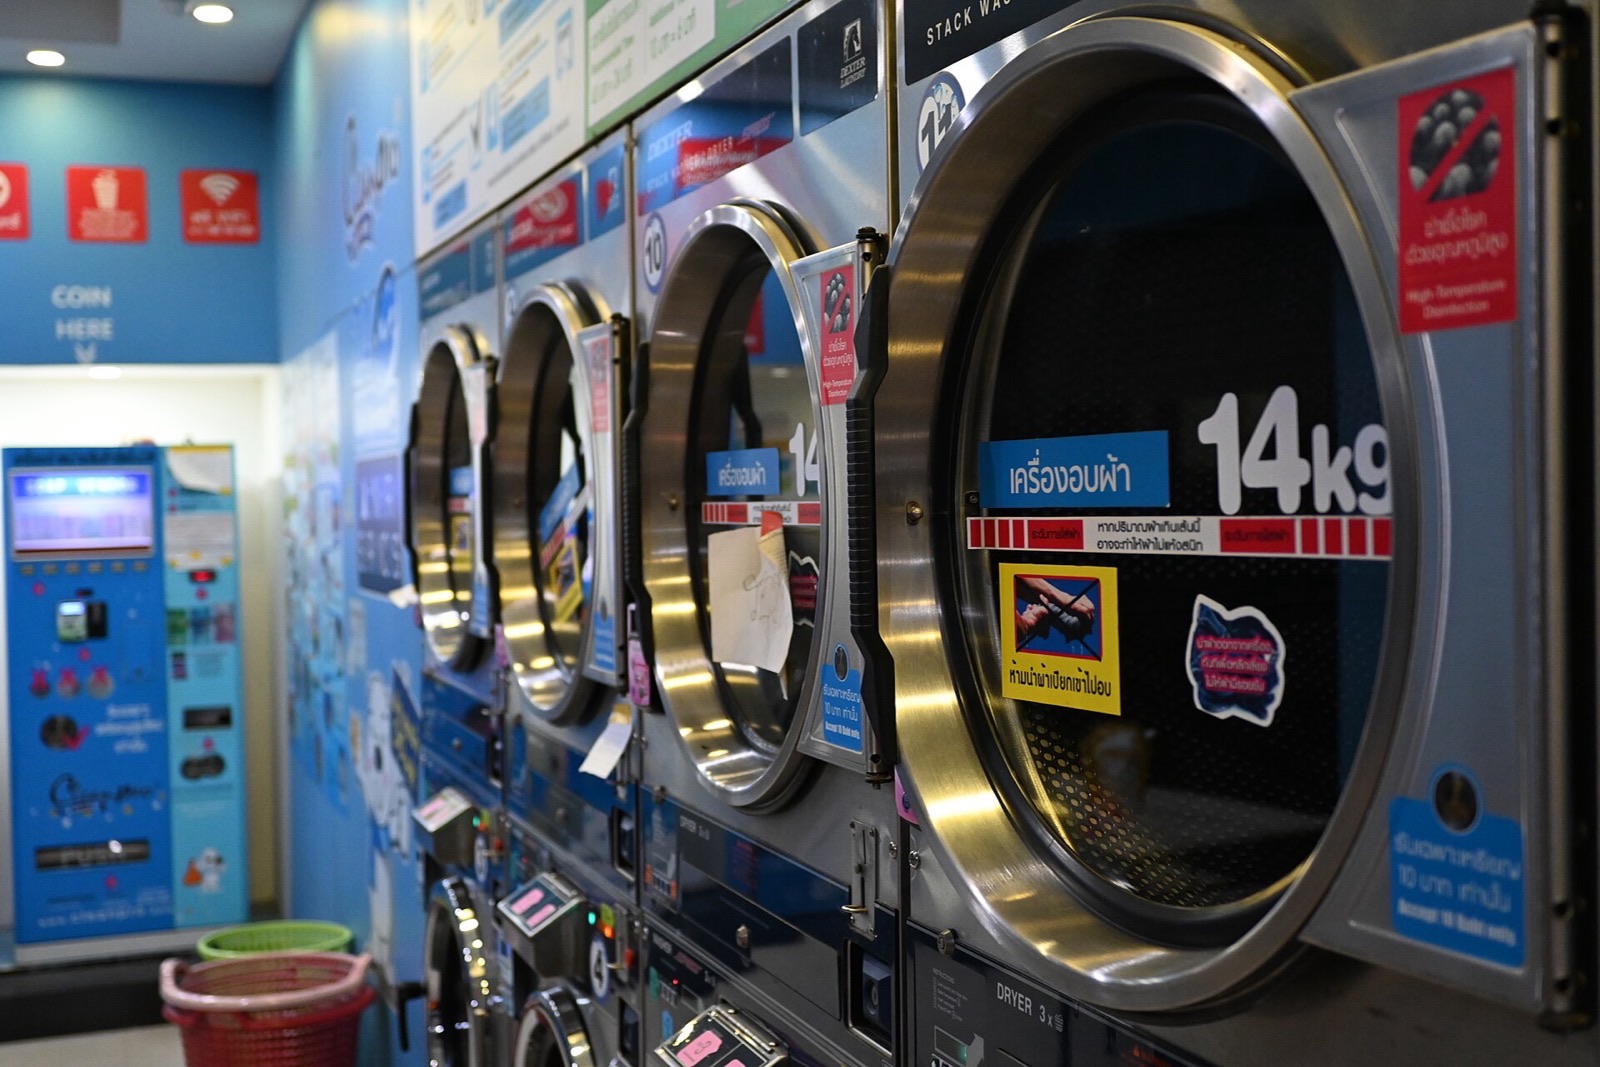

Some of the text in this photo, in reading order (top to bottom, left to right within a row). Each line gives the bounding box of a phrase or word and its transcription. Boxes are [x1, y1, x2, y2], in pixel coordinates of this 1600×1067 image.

[926, 6, 972, 46] STACK
[840, 56, 866, 79] DEXTER
[840, 67, 867, 89] LAUNDRY
[646, 232, 662, 274] 10
[51, 284, 112, 309] COIN
[55, 317, 115, 341] HERE
[1009, 449, 1131, 495] เครื่องอบผ้า
[1009, 659, 1112, 697] ห้ามนำผ้าเปียกเข้าไปอบ
[1398, 863, 1417, 889] 10
[1419, 874, 1453, 898] บาท
[997, 982, 1032, 1016] DRYER
[1039, 1004, 1046, 1023] 3
